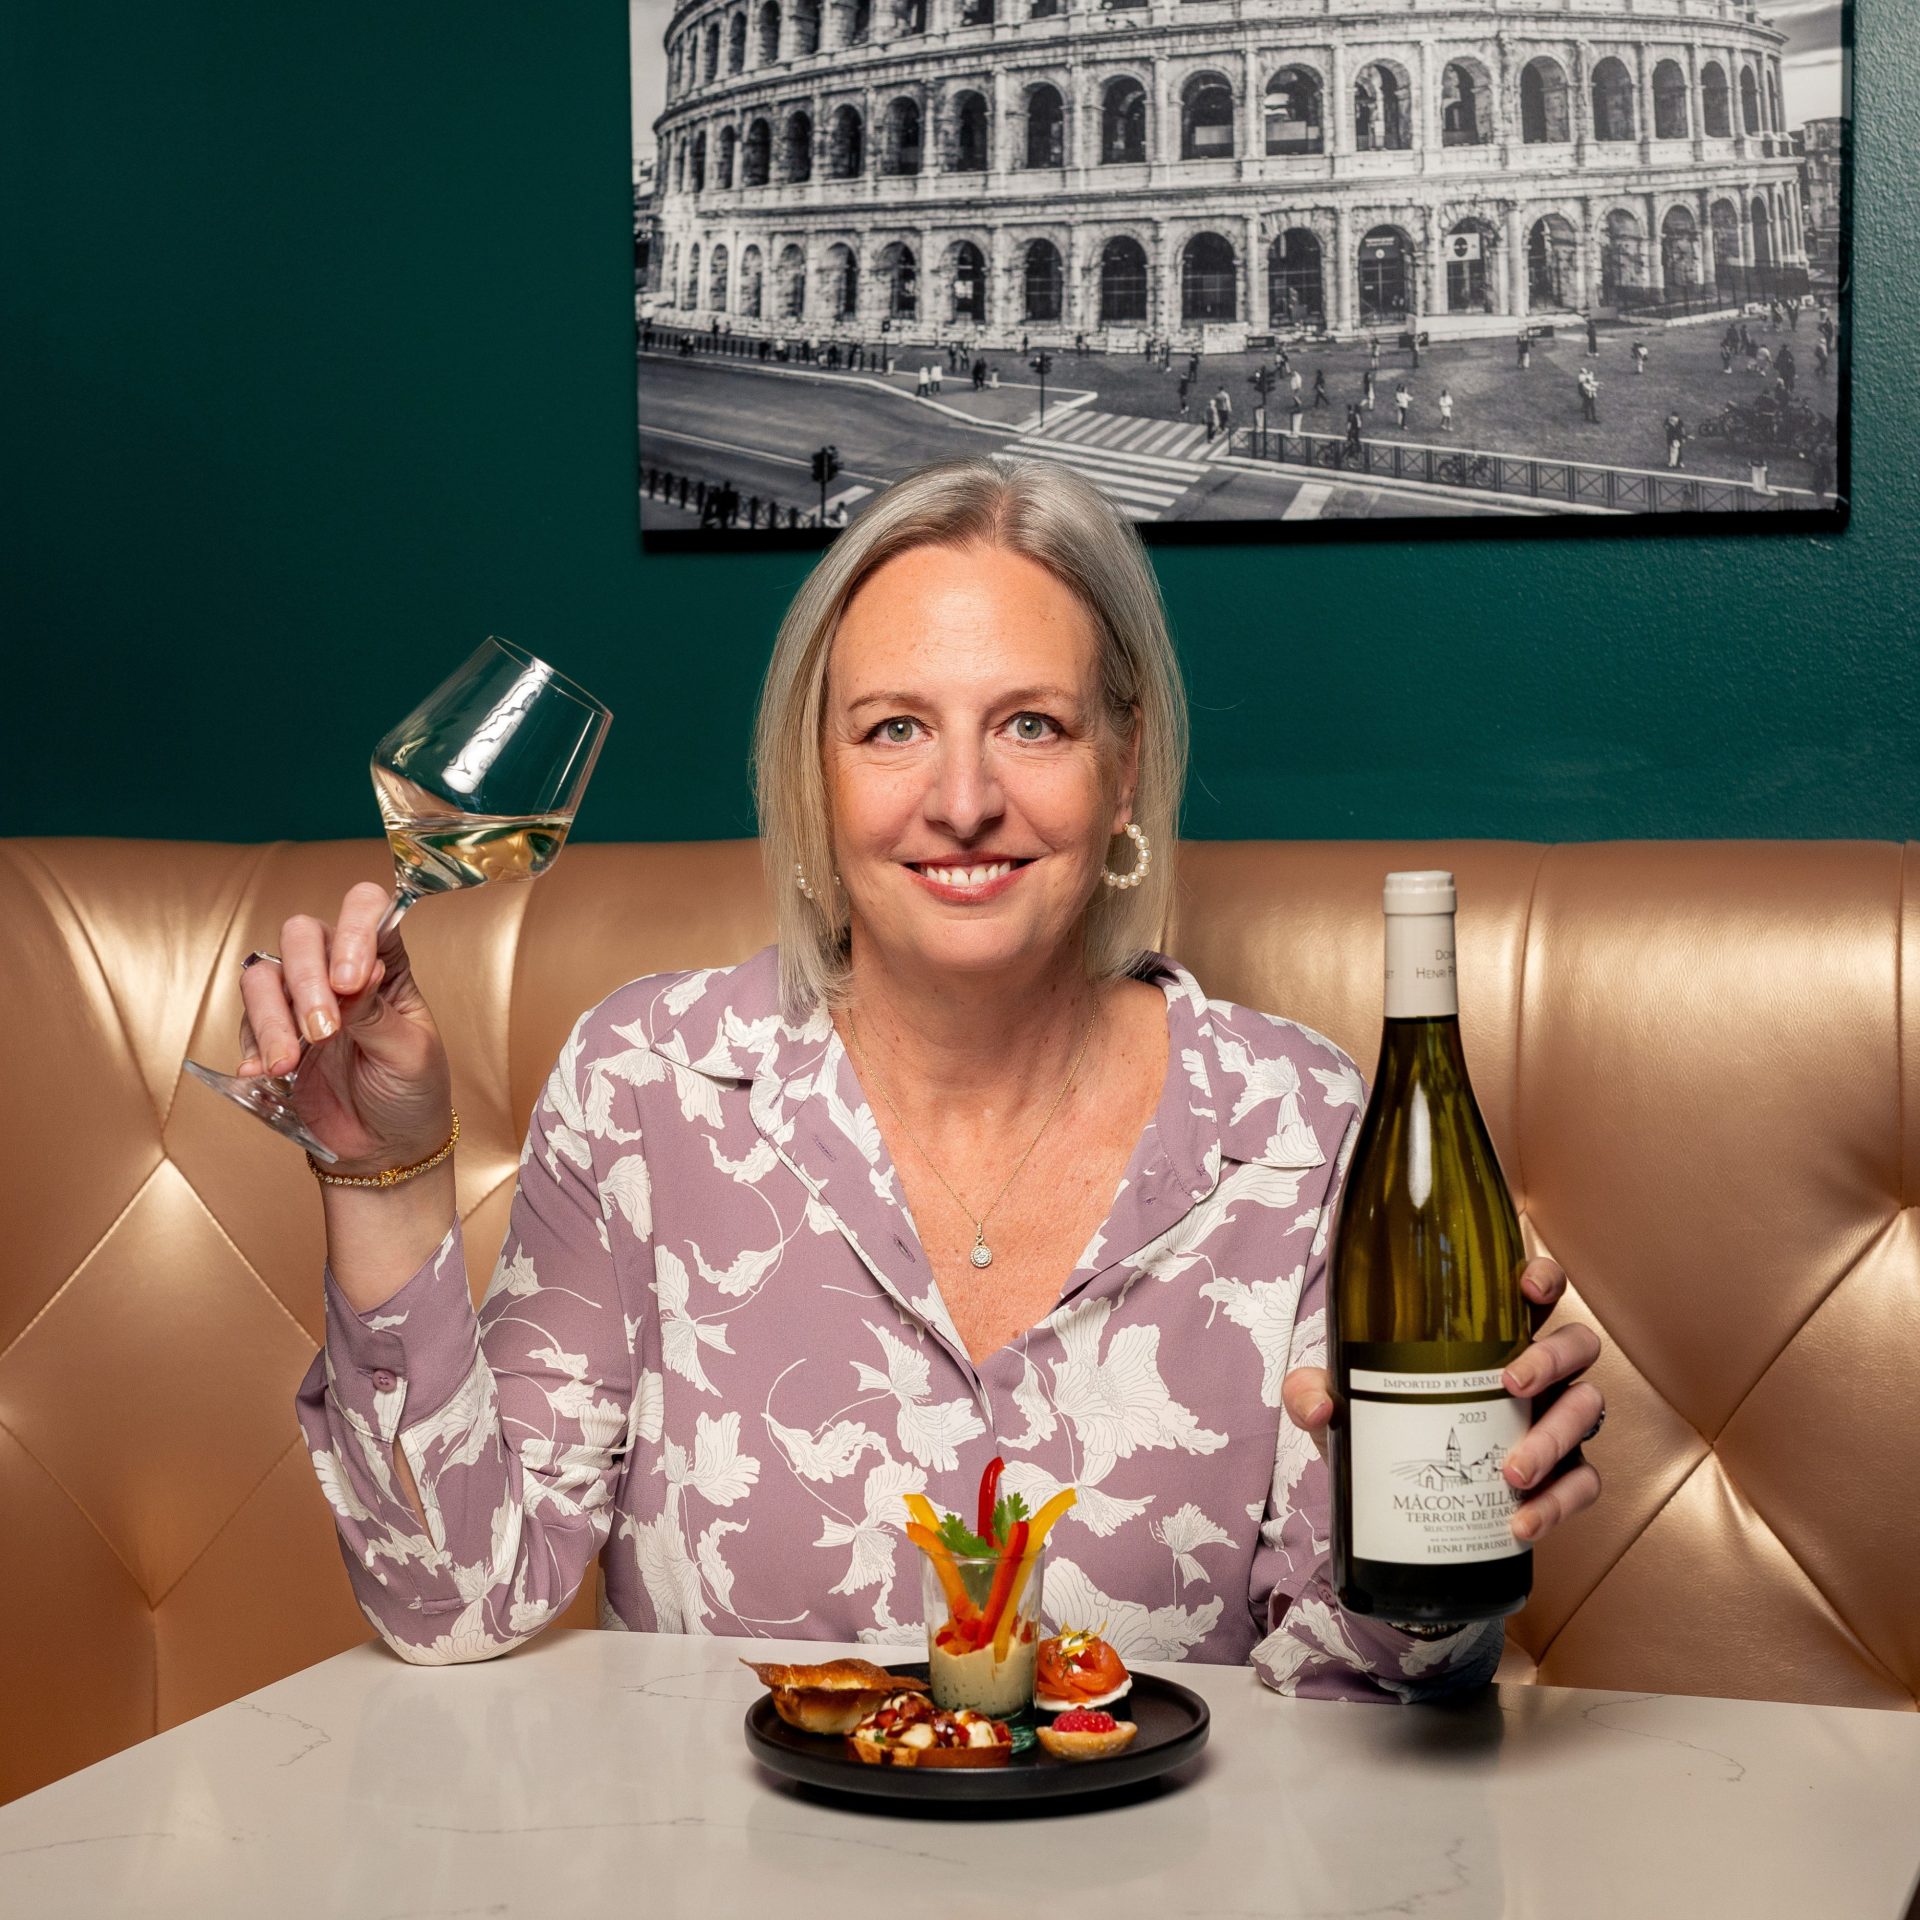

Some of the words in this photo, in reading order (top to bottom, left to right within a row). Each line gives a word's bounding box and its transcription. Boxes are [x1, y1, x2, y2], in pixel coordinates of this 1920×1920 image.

[1383, 1378, 1441, 1389] IMPORTED
[1445, 1379, 1458, 1388] BY
[1458, 1411, 1487, 1424] 2023
[1405, 1511, 1467, 1523] TERROIR
[1471, 1510, 1489, 1521] DE
[1427, 1543, 1463, 1554] HENRI
[1466, 1538, 1513, 1552] PERRUSSET
